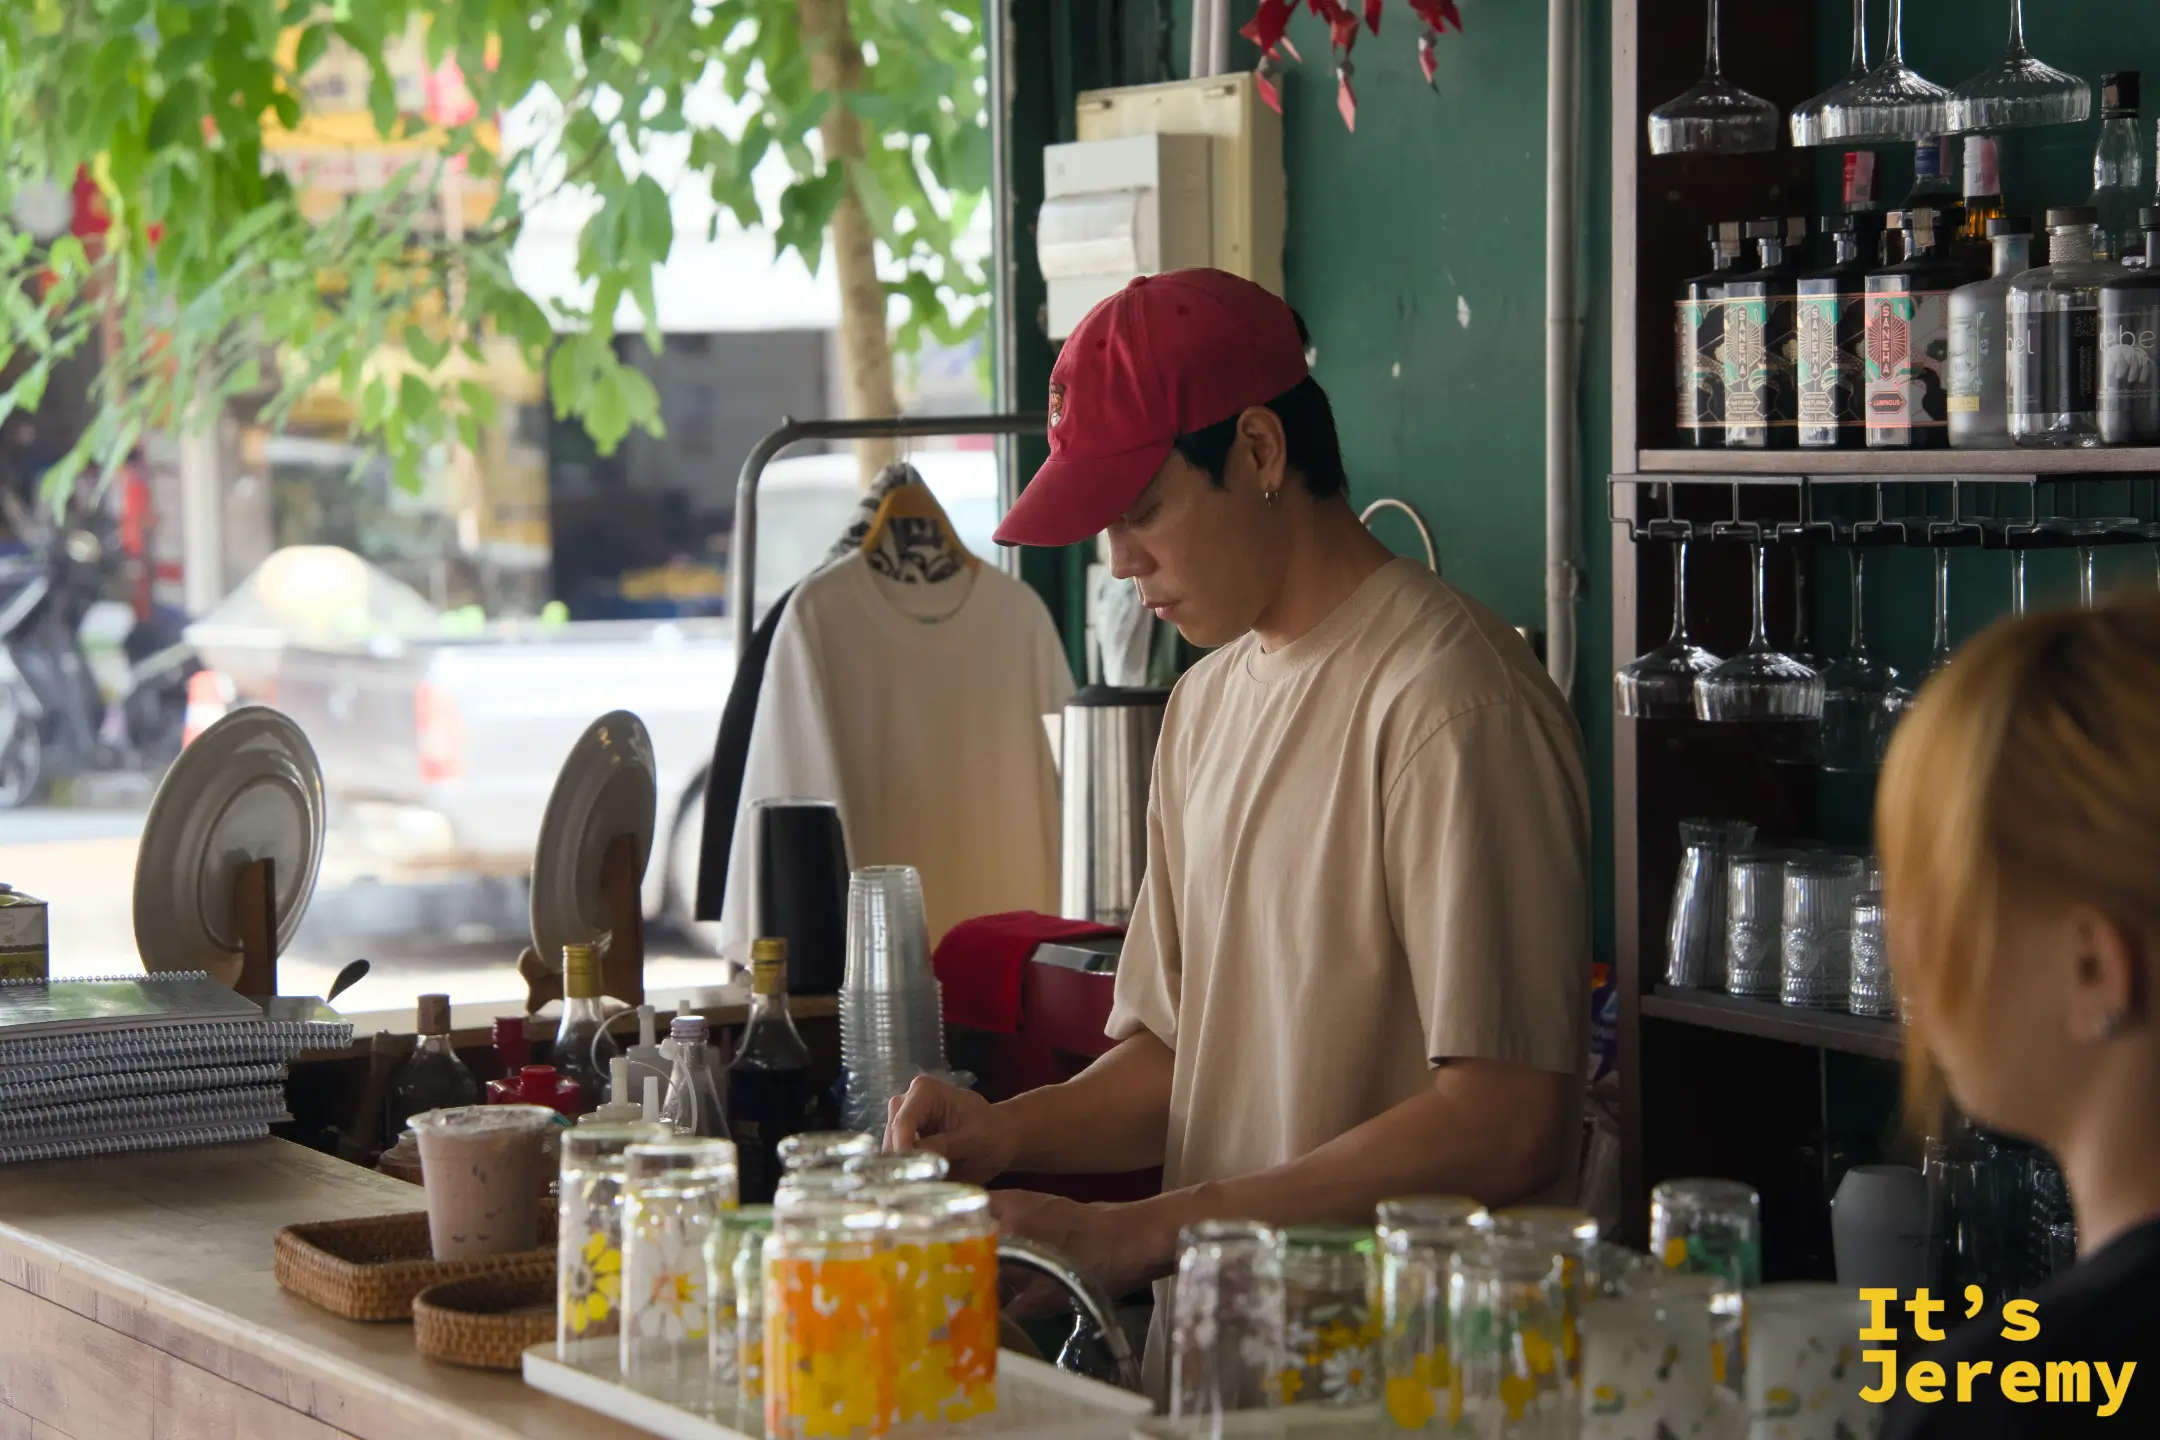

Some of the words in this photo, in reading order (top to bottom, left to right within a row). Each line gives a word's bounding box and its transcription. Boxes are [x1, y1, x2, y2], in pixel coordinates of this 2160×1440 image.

[1738, 309, 1746, 376] SANEHA
[1811, 307, 1819, 375] SANEHA
[1882, 306, 1890, 374] SANEHA
